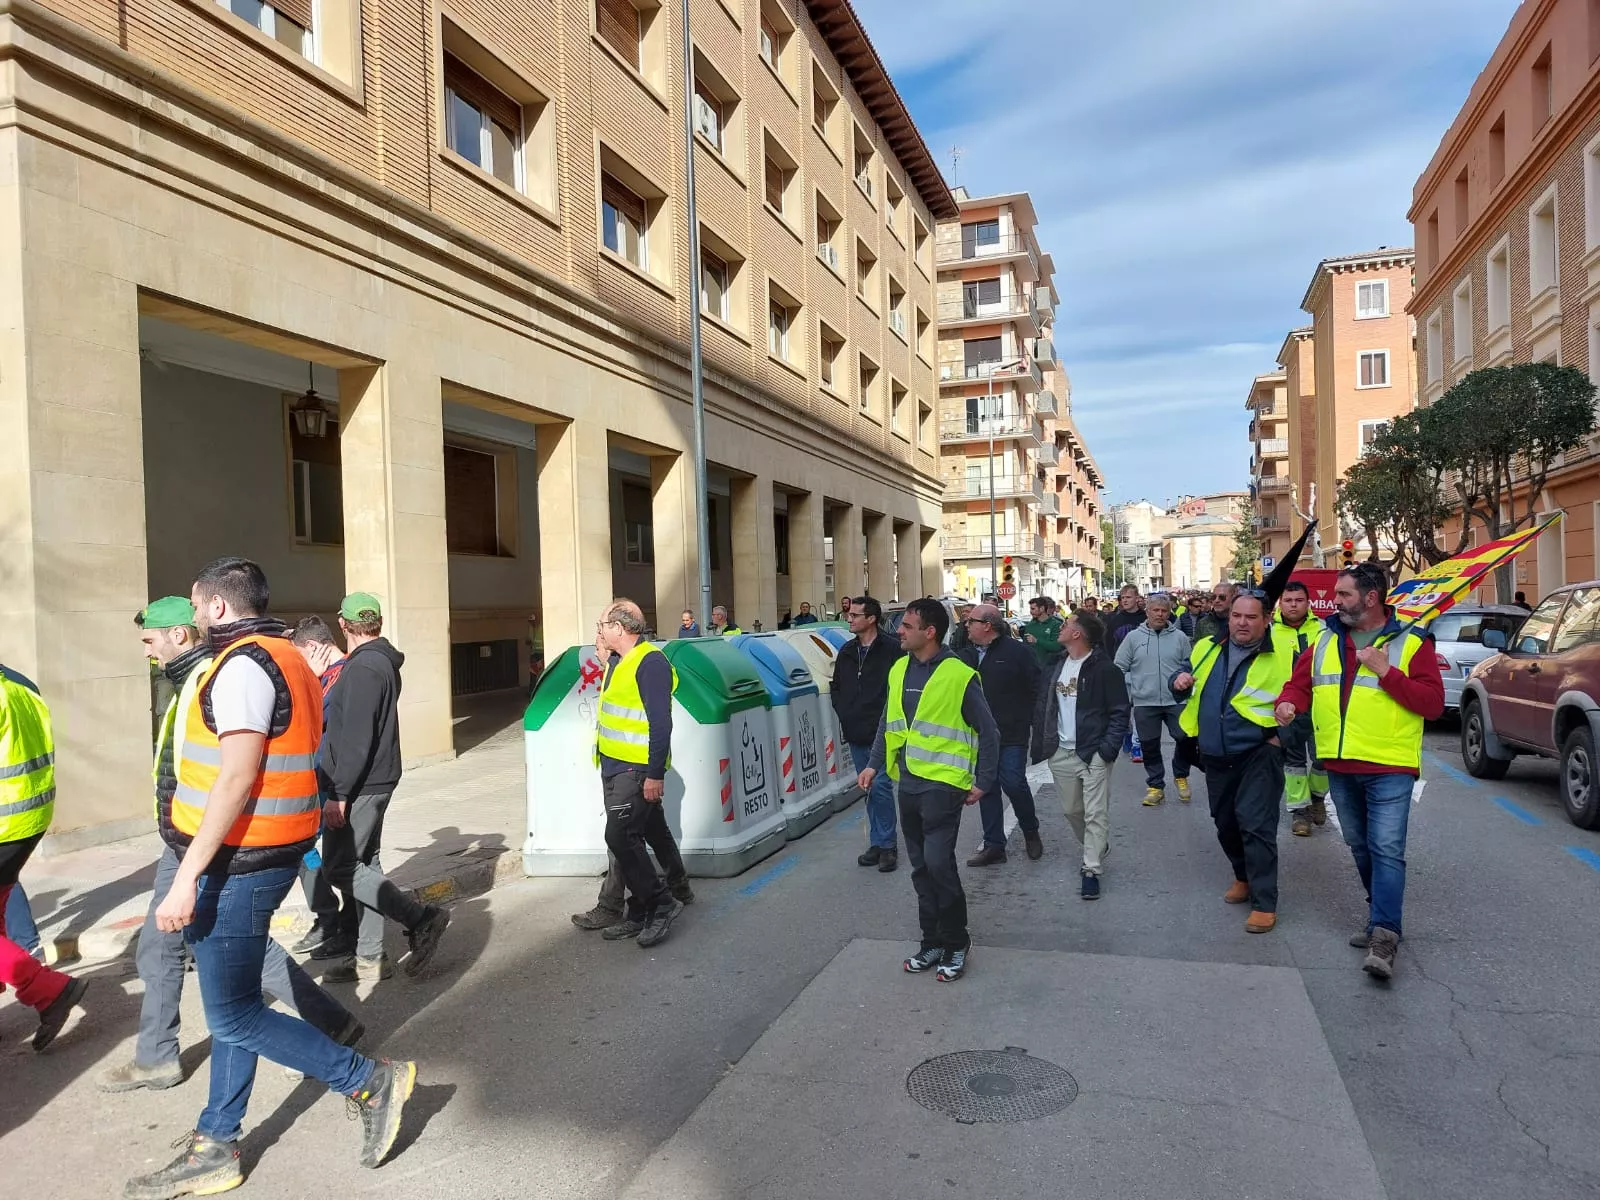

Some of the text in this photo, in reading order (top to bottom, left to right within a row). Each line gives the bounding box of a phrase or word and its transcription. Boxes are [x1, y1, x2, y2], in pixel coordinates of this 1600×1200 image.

[1264, 558, 1272, 566] P
[998, 586, 1015, 595] STOP
[1308, 599, 1338, 610] MBA
[802, 770, 820, 791] RESTO
[744, 792, 768, 816] RESTO
